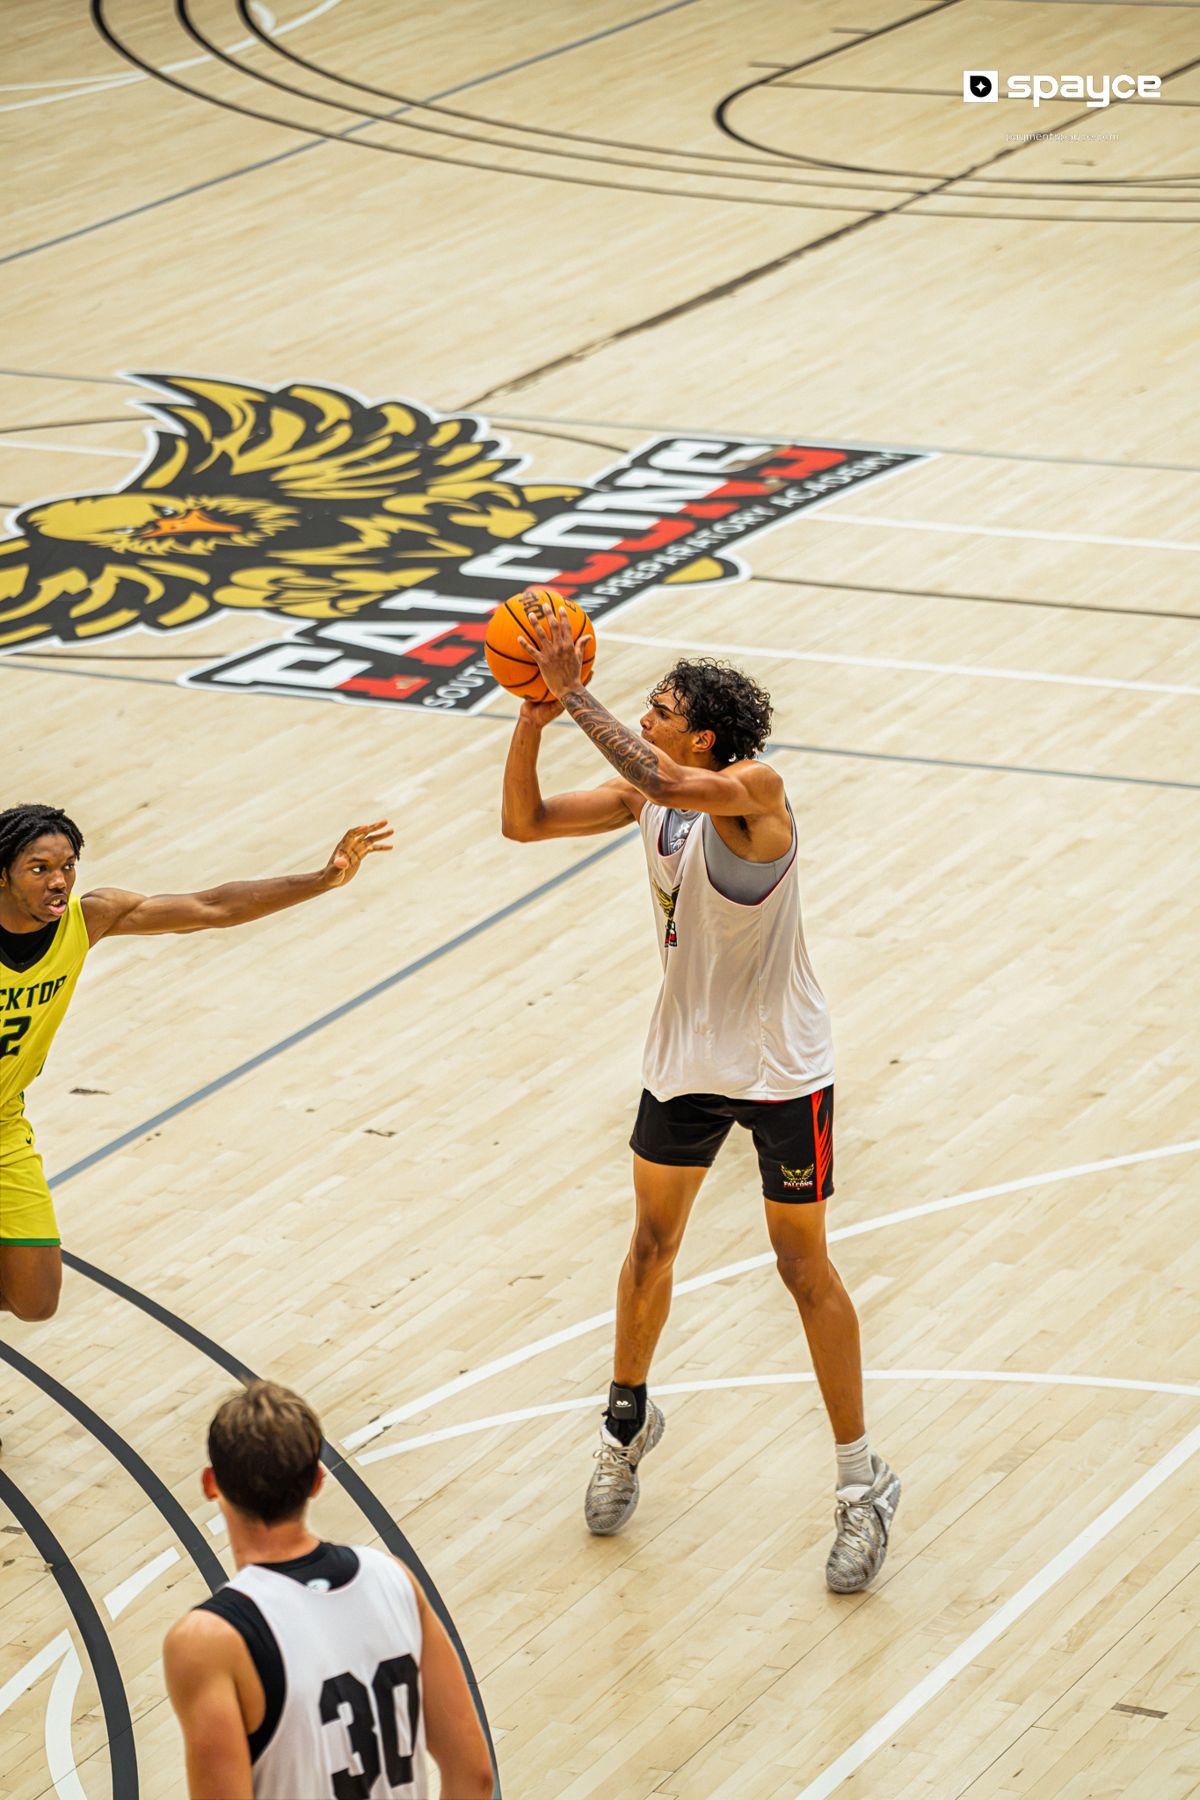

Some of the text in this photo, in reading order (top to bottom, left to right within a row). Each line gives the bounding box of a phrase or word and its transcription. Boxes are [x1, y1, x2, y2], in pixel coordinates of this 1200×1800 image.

[212, 440, 849, 699] FALCONS
[592, 505, 777, 597] PREPARATORY
[769, 451, 905, 508] ACADEMY
[783, 1180, 814, 1189] FALCONS
[318, 1653, 421, 1800] 30
